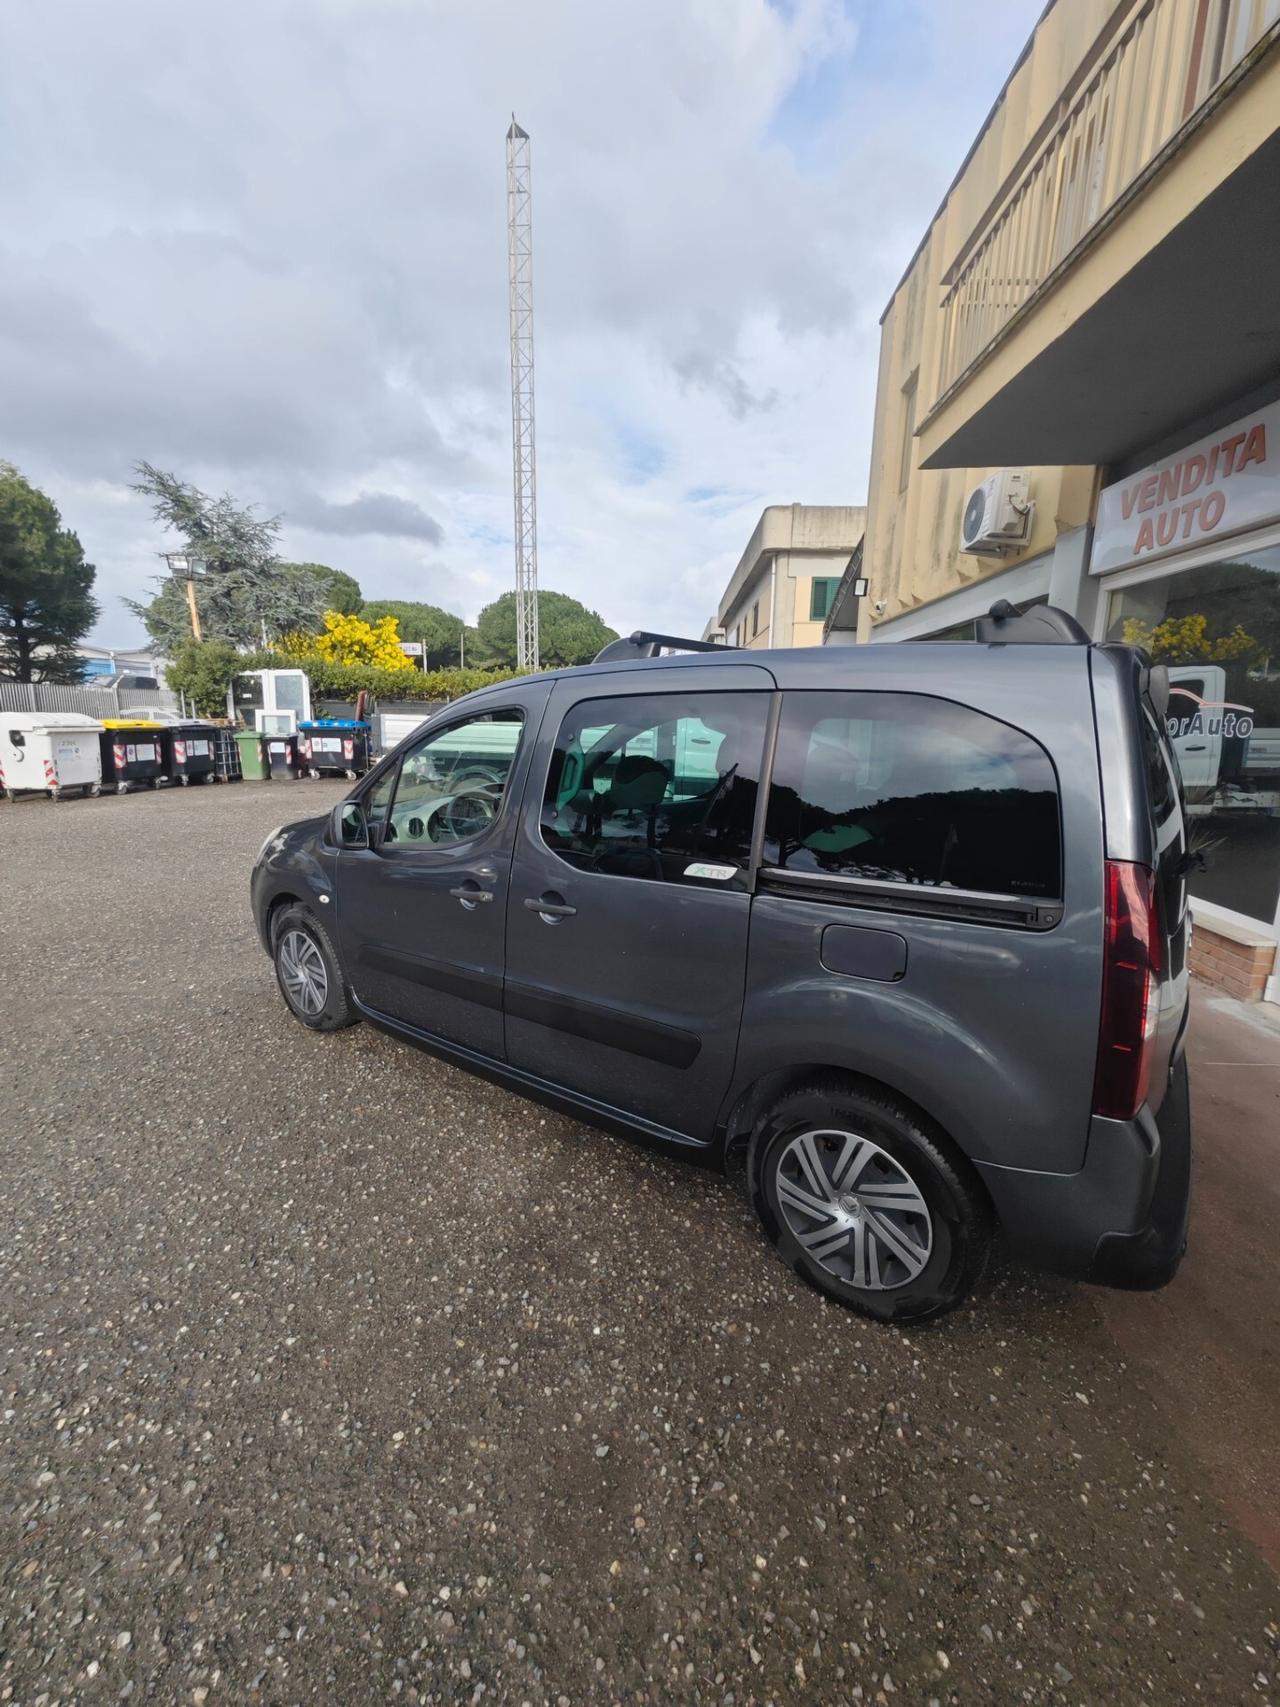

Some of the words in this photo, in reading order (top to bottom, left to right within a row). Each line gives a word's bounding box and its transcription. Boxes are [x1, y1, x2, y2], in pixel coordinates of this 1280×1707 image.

[1120, 423, 1267, 520] VENDITA
[1132, 490, 1226, 555] AUTO
[1166, 712, 1254, 739] orAuto
